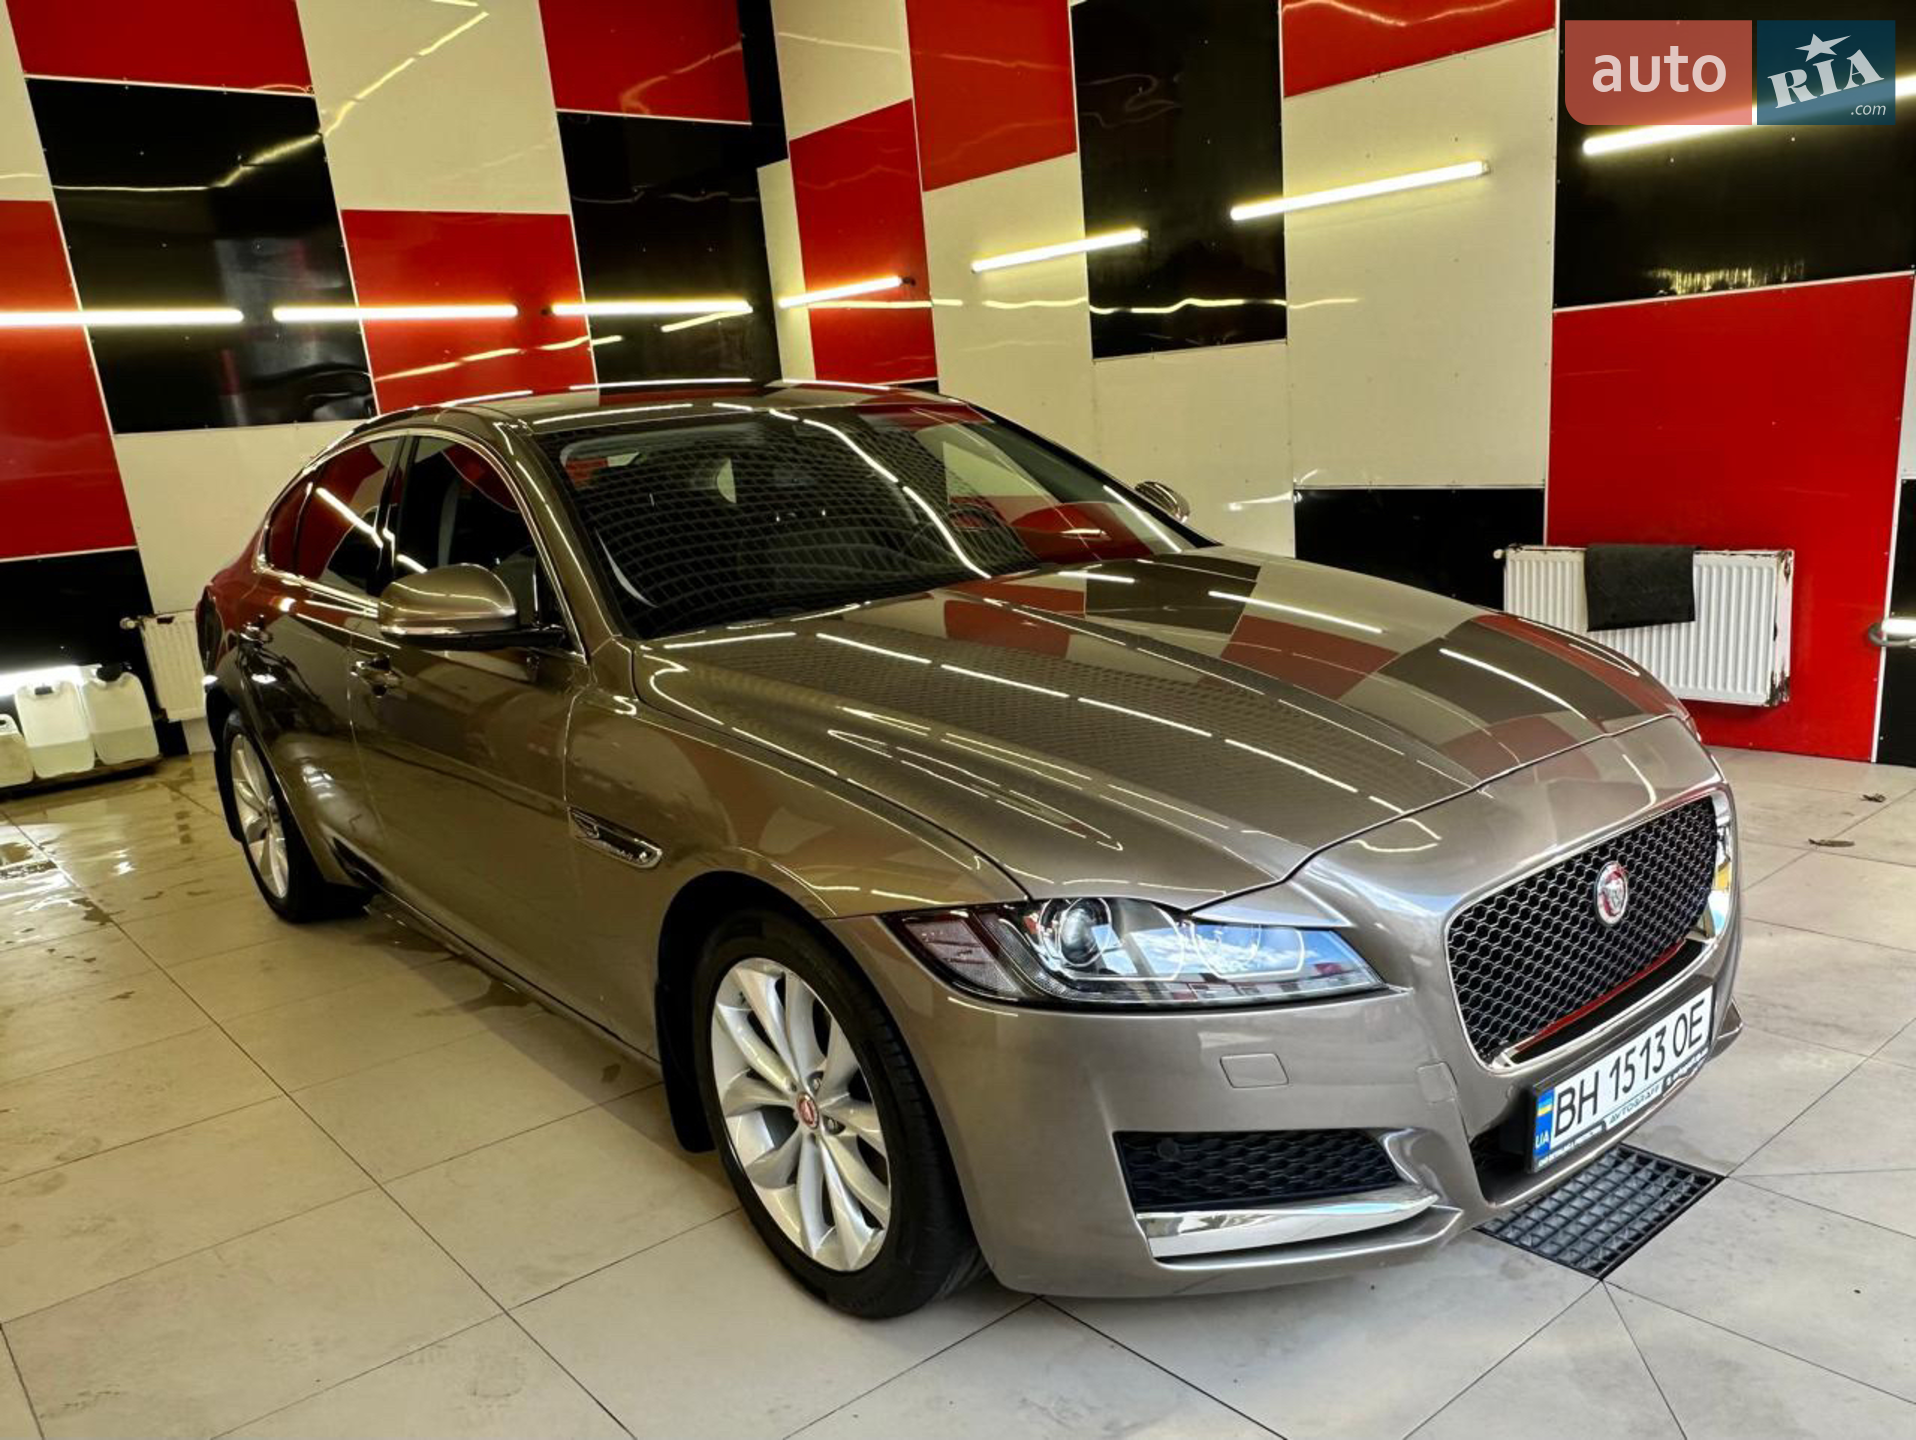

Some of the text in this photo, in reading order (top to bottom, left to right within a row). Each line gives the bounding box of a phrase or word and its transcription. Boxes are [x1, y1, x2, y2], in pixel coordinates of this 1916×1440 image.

[1554, 1072, 1599, 1138] BH
[1609, 1025, 1667, 1101] 1513
[1672, 998, 1705, 1058] OE
[1535, 1130, 1550, 1149] UA
